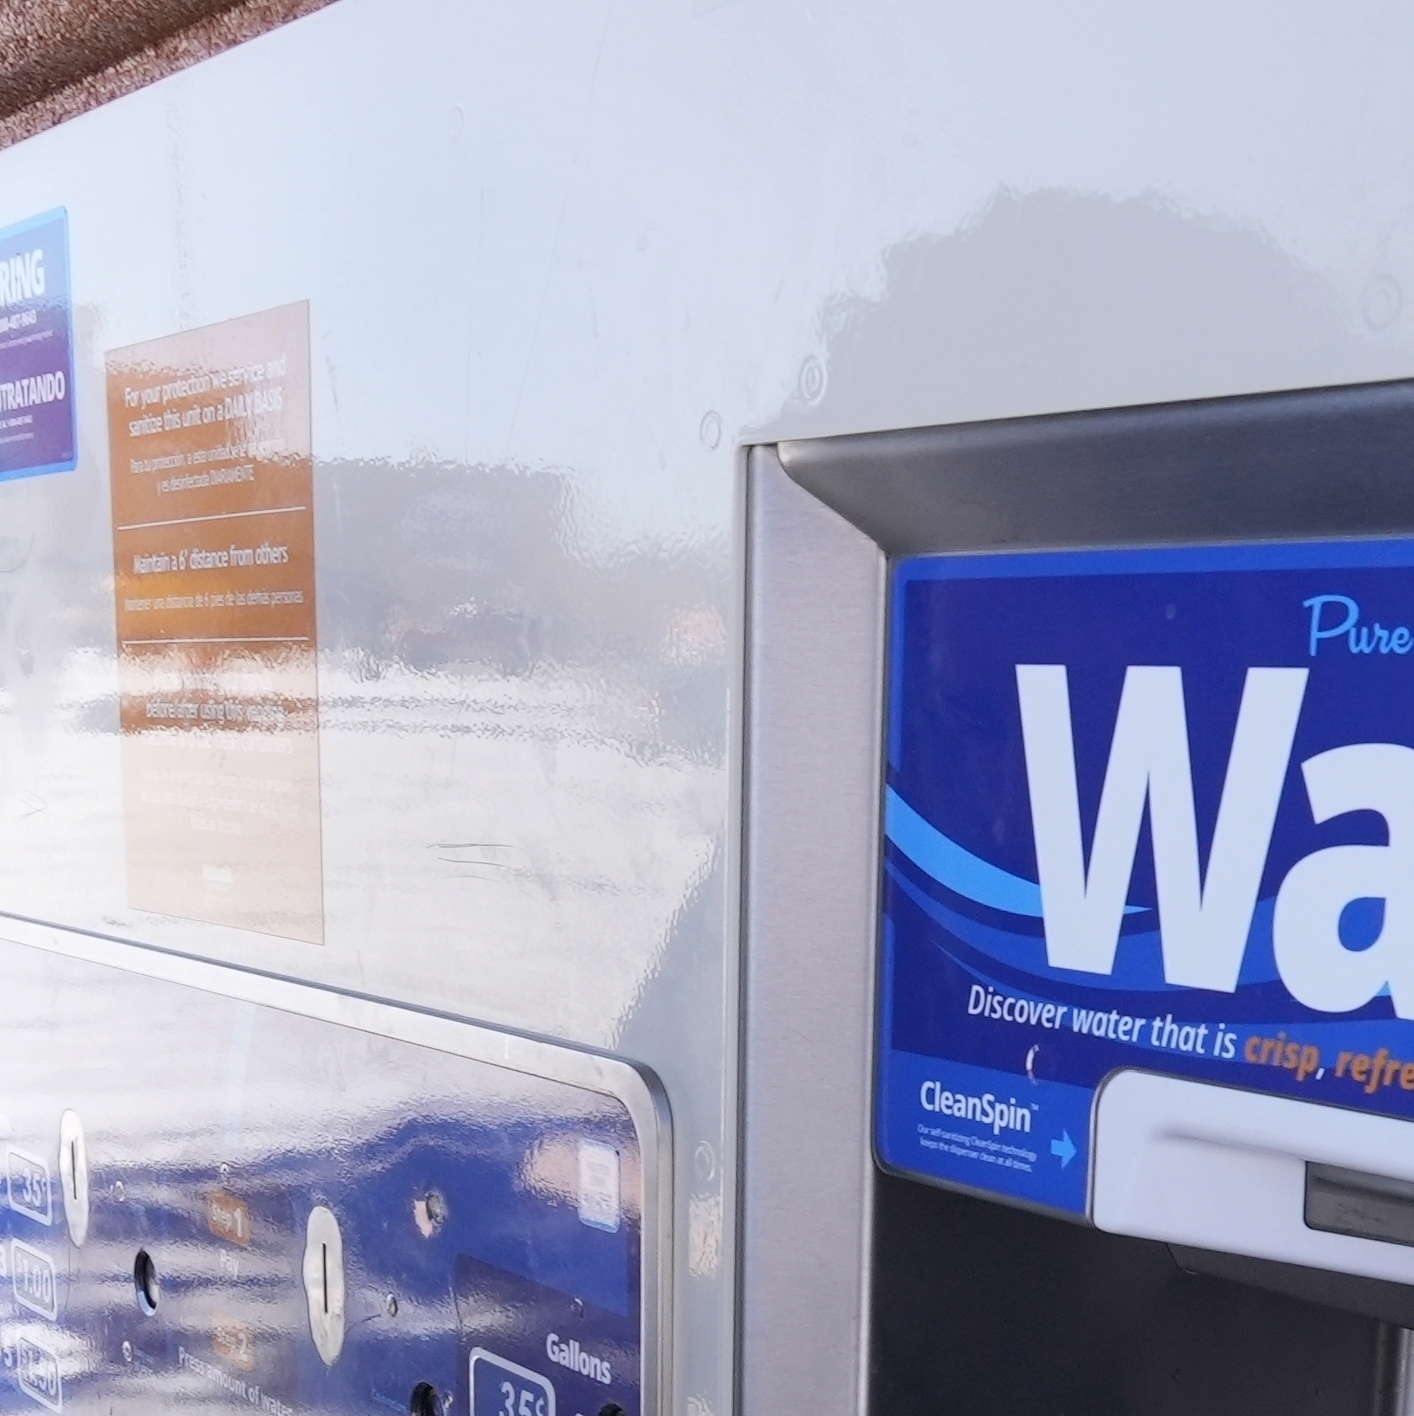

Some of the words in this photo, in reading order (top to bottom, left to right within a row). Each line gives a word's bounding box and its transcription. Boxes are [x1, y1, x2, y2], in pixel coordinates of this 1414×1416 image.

[125, 387, 140, 408] For
[141, 385, 161, 410] your
[162, 375, 210, 406] protection
[129, 413, 163, 437] sanitize
[164, 408, 181, 430] this
[182, 404, 202, 427] unit
[203, 408, 216, 424] on
[224, 393, 253, 420] DAILY
[133, 552, 170, 575] Maintain
[171, 556, 178, 571] a
[189, 548, 228, 570] distance
[230, 544, 254, 566] from
[255, 542, 289, 564] others
[1303, 592, 1413, 659] Pure
[967, 984, 1068, 1030] Discover
[1071, 1006, 1147, 1043] water
[1151, 1014, 1206, 1056] that
[1213, 1023, 1237, 1060] is
[1244, 1031, 1326, 1083] crisp,
[211, 1202, 232, 1229] Step
[234, 1207, 243, 1238] 1
[238, 1332, 249, 1363] 2
[546, 1332, 612, 1385] Gallons
[179, 1346, 207, 1379] Press
[207, 1367, 246, 1399] amount
[248, 1383, 259, 1404] of
